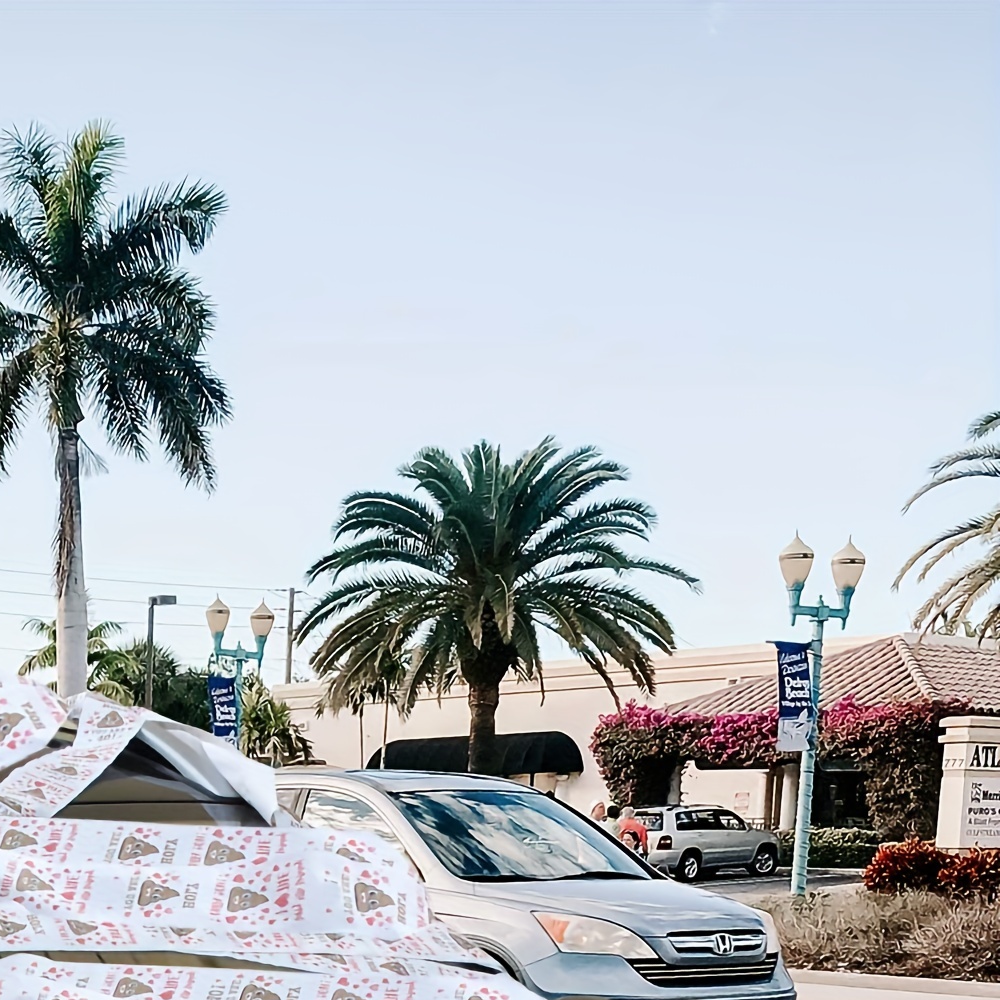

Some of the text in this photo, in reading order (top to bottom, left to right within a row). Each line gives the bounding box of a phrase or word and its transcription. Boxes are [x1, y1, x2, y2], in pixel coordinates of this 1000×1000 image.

[785, 688, 809, 699] Beach
[945, 759, 964, 767] 777
[970, 745, 1000, 768] ATL
[160, 838, 179, 864] HOLY
[182, 883, 200, 909] HOLY
